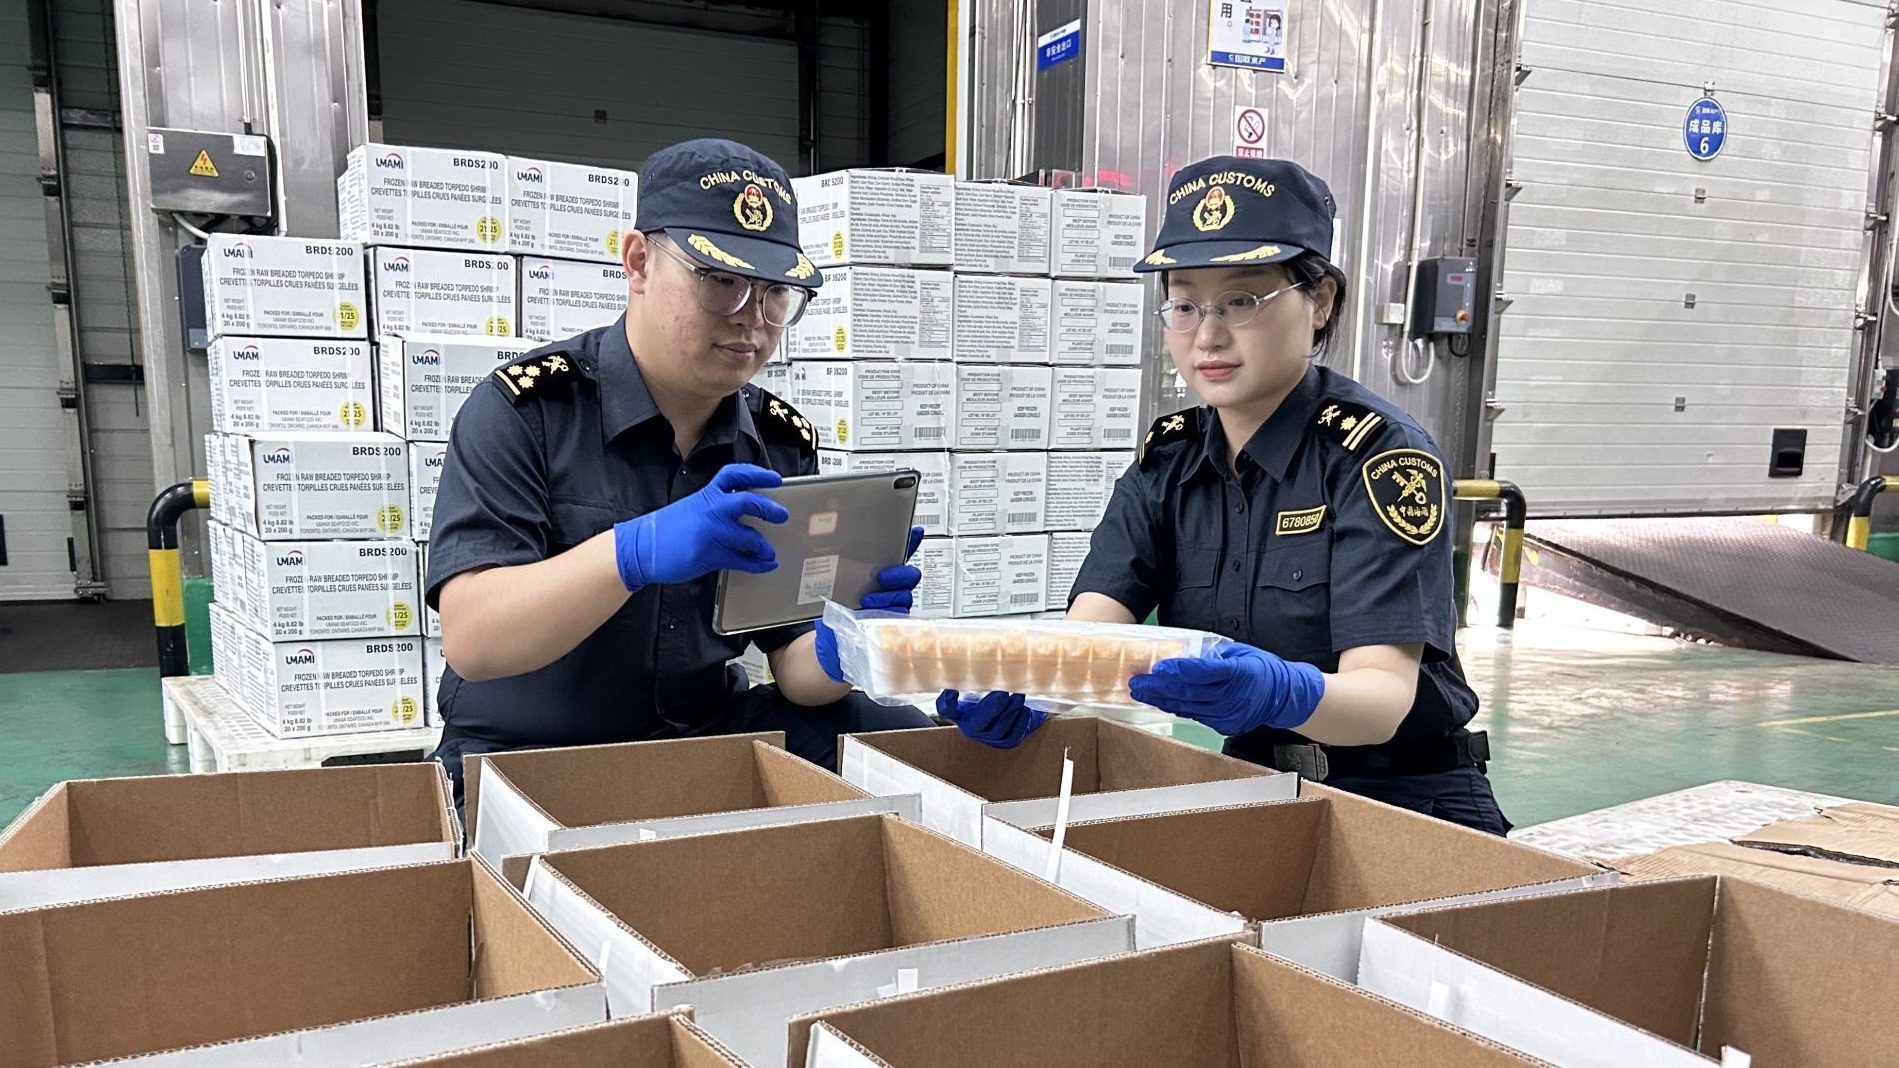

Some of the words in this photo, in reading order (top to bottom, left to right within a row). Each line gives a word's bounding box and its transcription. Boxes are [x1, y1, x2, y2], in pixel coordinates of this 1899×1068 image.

[1689, 119, 1722, 134] 成品库
[1700, 137, 1709, 154] 6
[376, 159, 403, 169] UMAMI
[517, 172, 542, 183] UMAMI
[588, 174, 629, 186] BRDS20
[384, 178, 405, 187] FROZEN
[419, 181, 443, 190] BREADED
[445, 182, 469, 192] TORPEDO
[700, 171, 740, 189] CHINA
[743, 170, 792, 204] CUSTOMS
[1170, 178, 1205, 204] CHINA
[1209, 172, 1274, 197] CUSTOMS
[371, 188, 402, 197] CREVETTES
[432, 192, 449, 200] CRUES
[523, 191, 543, 200] FROZEN
[556, 194, 578, 204] BREADED
[580, 197, 601, 207] TORPEDO
[511, 199, 539, 209] CREVETTES
[567, 205, 582, 214] CRUES
[480, 225, 497, 233] 2125
[384, 263, 409, 272] UMAM
[465, 260, 508, 270] BRDS00
[257, 269, 268, 277] RAW
[270, 270, 296, 278] BREADED
[298, 271, 323, 279] TORPEDO
[603, 270, 626, 279] BRDS
[254, 279, 283, 287] TORPILLES
[285, 280, 303, 288] CRUES
[430, 282, 454, 290] BREADED
[383, 290, 410, 299] CREVETTE
[414, 292, 441, 300] TORPILLES
[443, 293, 460, 301] CRUES
[556, 299, 580, 307] TORPILLES
[234, 351, 259, 360] UMAM
[413, 356, 440, 365] UMAMI
[242, 370, 260, 378] FROZE
[266, 370, 277, 378] RAW
[306, 371, 331, 379] TORPEDO
[264, 455, 290, 463] UMAM
[1371, 460, 1398, 479] CHINA
[1399, 457, 1437, 477] CUSTOMS
[263, 484, 292, 492] CREVETTE
[298, 483, 328, 491] TORPILLES
[330, 483, 348, 491] CRUES
[350, 483, 371, 491] PANÉES
[373, 483, 404, 491] SURELÉES
[277, 557, 302, 566] UMAM
[286, 575, 303, 583] FROZE
[310, 575, 322, 583] RAW
[324, 574, 350, 582] BREADED
[351, 574, 377, 582] TORPEDO
[338, 584, 356, 592] CRUES
[286, 656, 314, 664] UMAMI
[295, 673, 316, 681] FROZEN
[332, 671, 357, 679] BREADED
[359, 670, 383, 678] TORPEDO
[282, 682, 313, 692] CREVETTES
[346, 680, 363, 688] CRUES
[365, 678, 385, 687] PANÉES
[387, 677, 417, 686] SURELÉES
